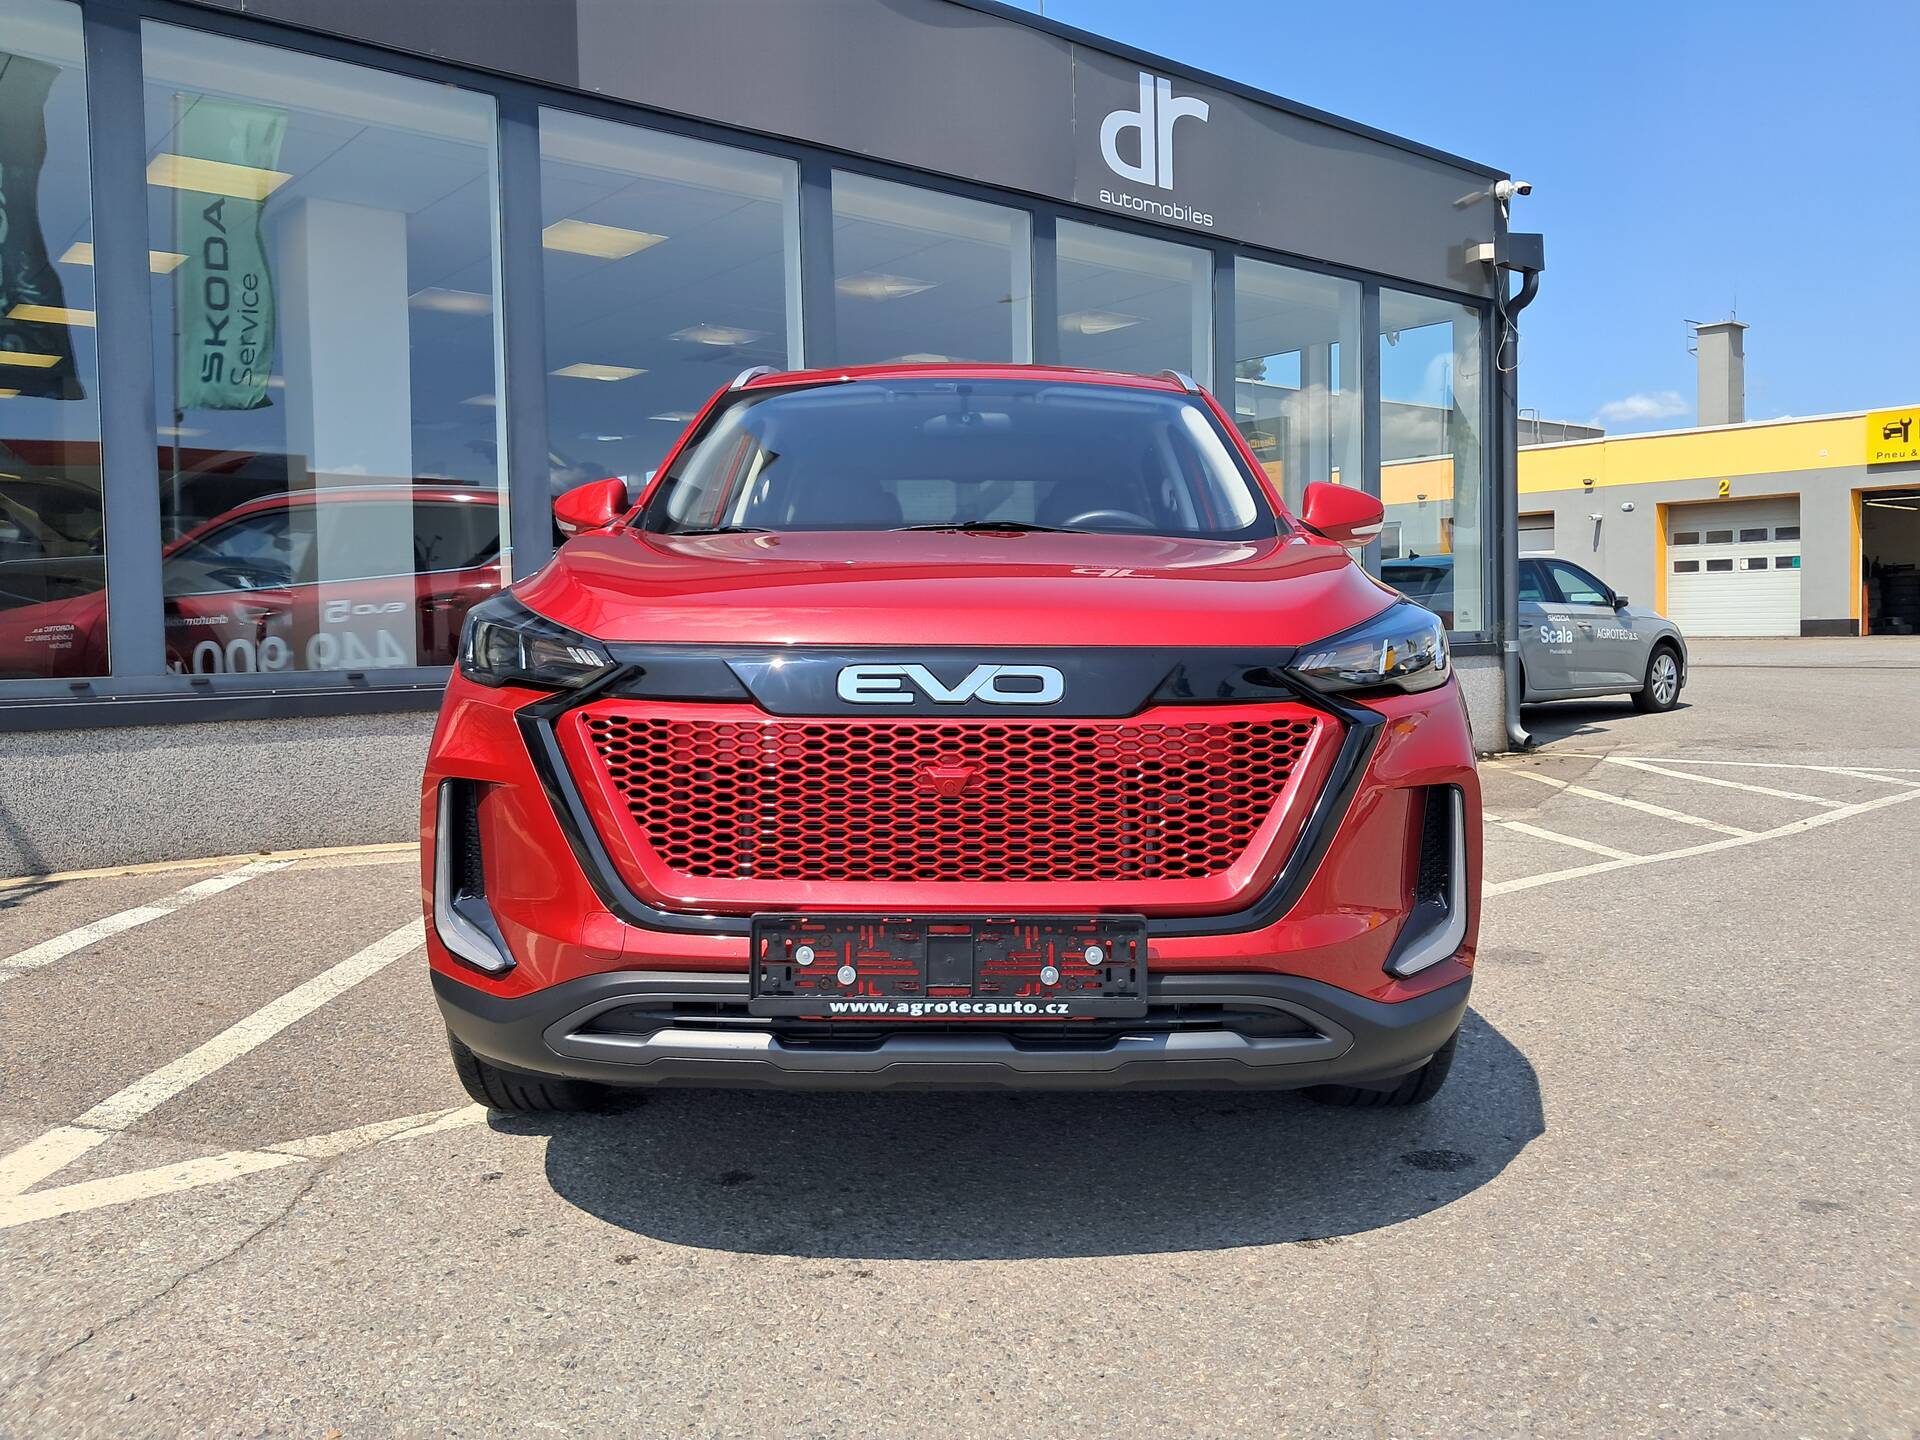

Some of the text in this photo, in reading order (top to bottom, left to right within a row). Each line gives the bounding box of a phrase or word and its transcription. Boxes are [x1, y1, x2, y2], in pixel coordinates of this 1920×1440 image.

[1099, 71, 1210, 191] dr
[1099, 188, 1214, 228] automobiles
[230, 272, 260, 387] Service
[1876, 450, 1906, 460] Pneu
[1718, 479, 1730, 495] 2
[1540, 625, 1573, 644] Scala
[1596, 628, 1629, 640] AGROTEC
[837, 664, 1064, 704] EVO
[829, 1001, 1069, 1016] www.agrotecauto.cz
